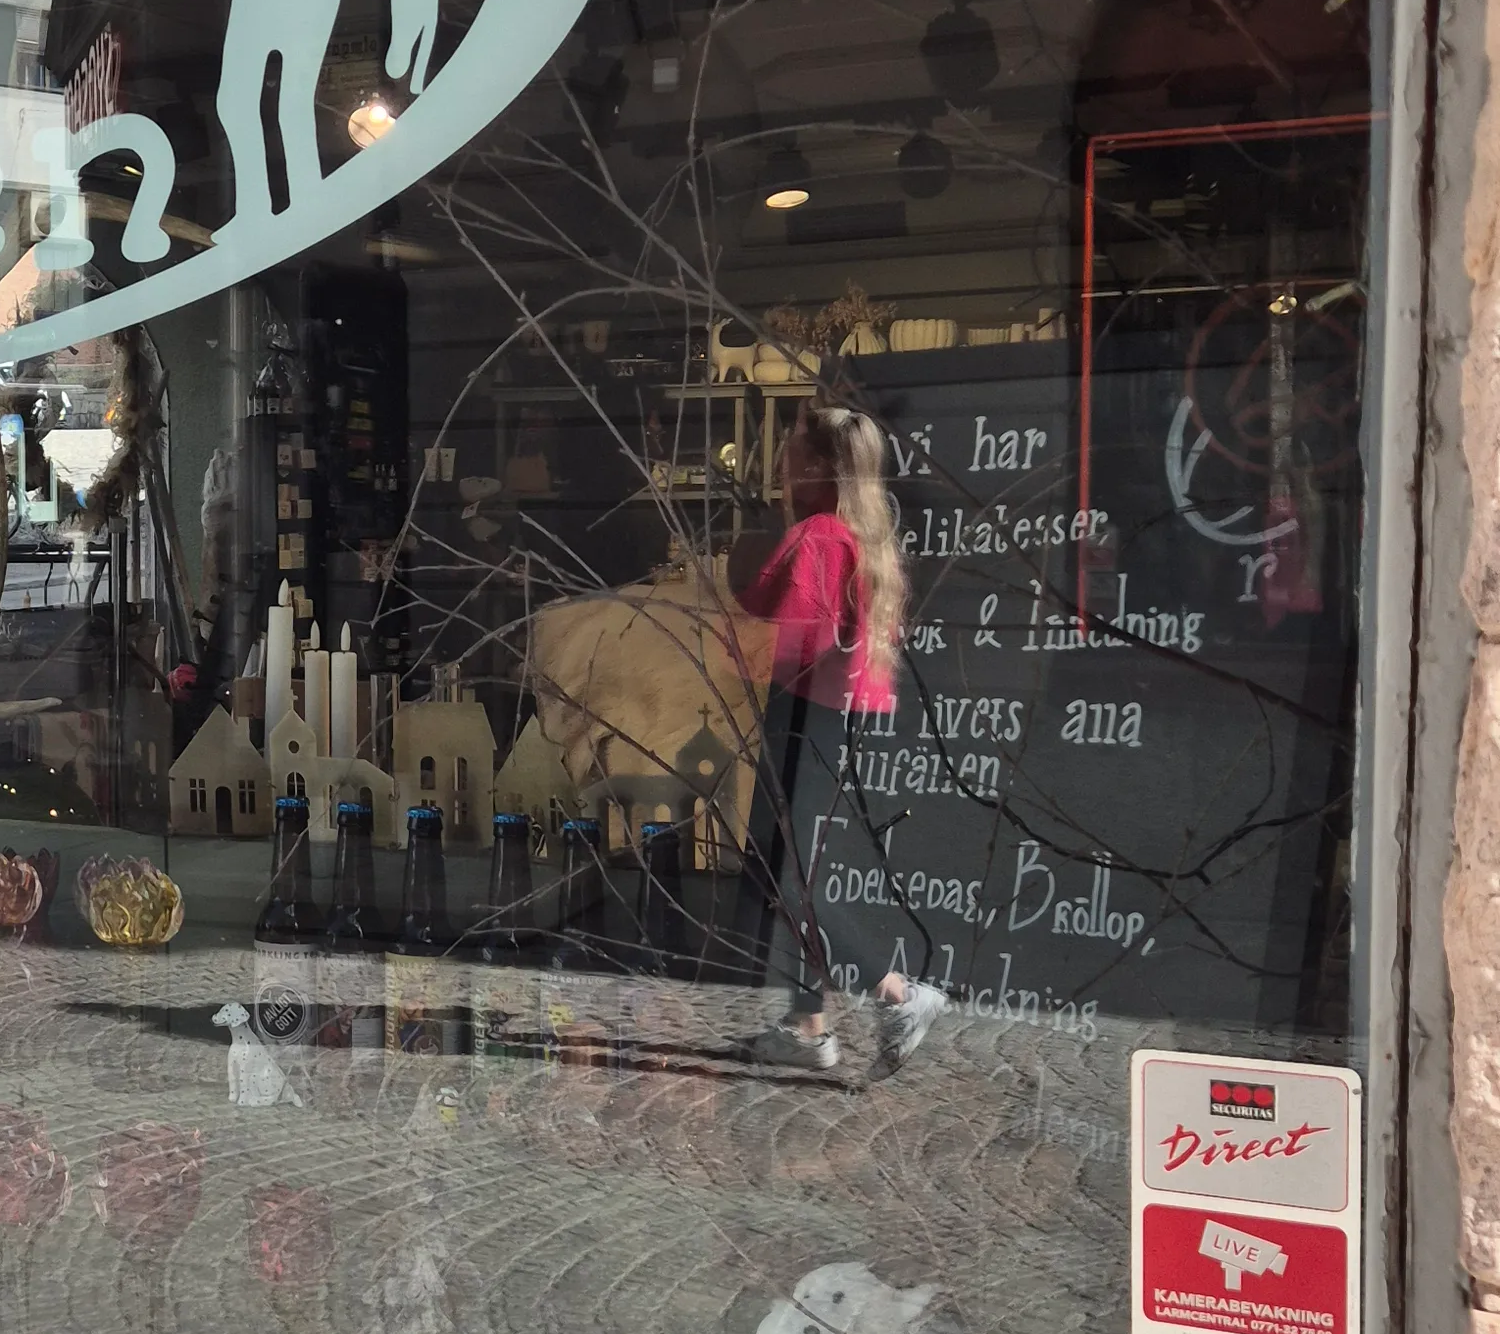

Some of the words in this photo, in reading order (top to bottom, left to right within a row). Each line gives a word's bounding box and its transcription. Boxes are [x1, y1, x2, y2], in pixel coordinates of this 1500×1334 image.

[969, 414, 1048, 471] har
[889, 489, 1110, 558] elikatesser,
[274, 1006, 299, 1032] GOTT
[1211, 1102, 1273, 1120] SECURITAS
[1156, 1122, 1332, 1172] Direct
[1212, 1233, 1260, 1263] LIVE
[1153, 1288, 1334, 1328] KAMERABEVAKNING
[1155, 1305, 1248, 1330] LARMCENTRAL
